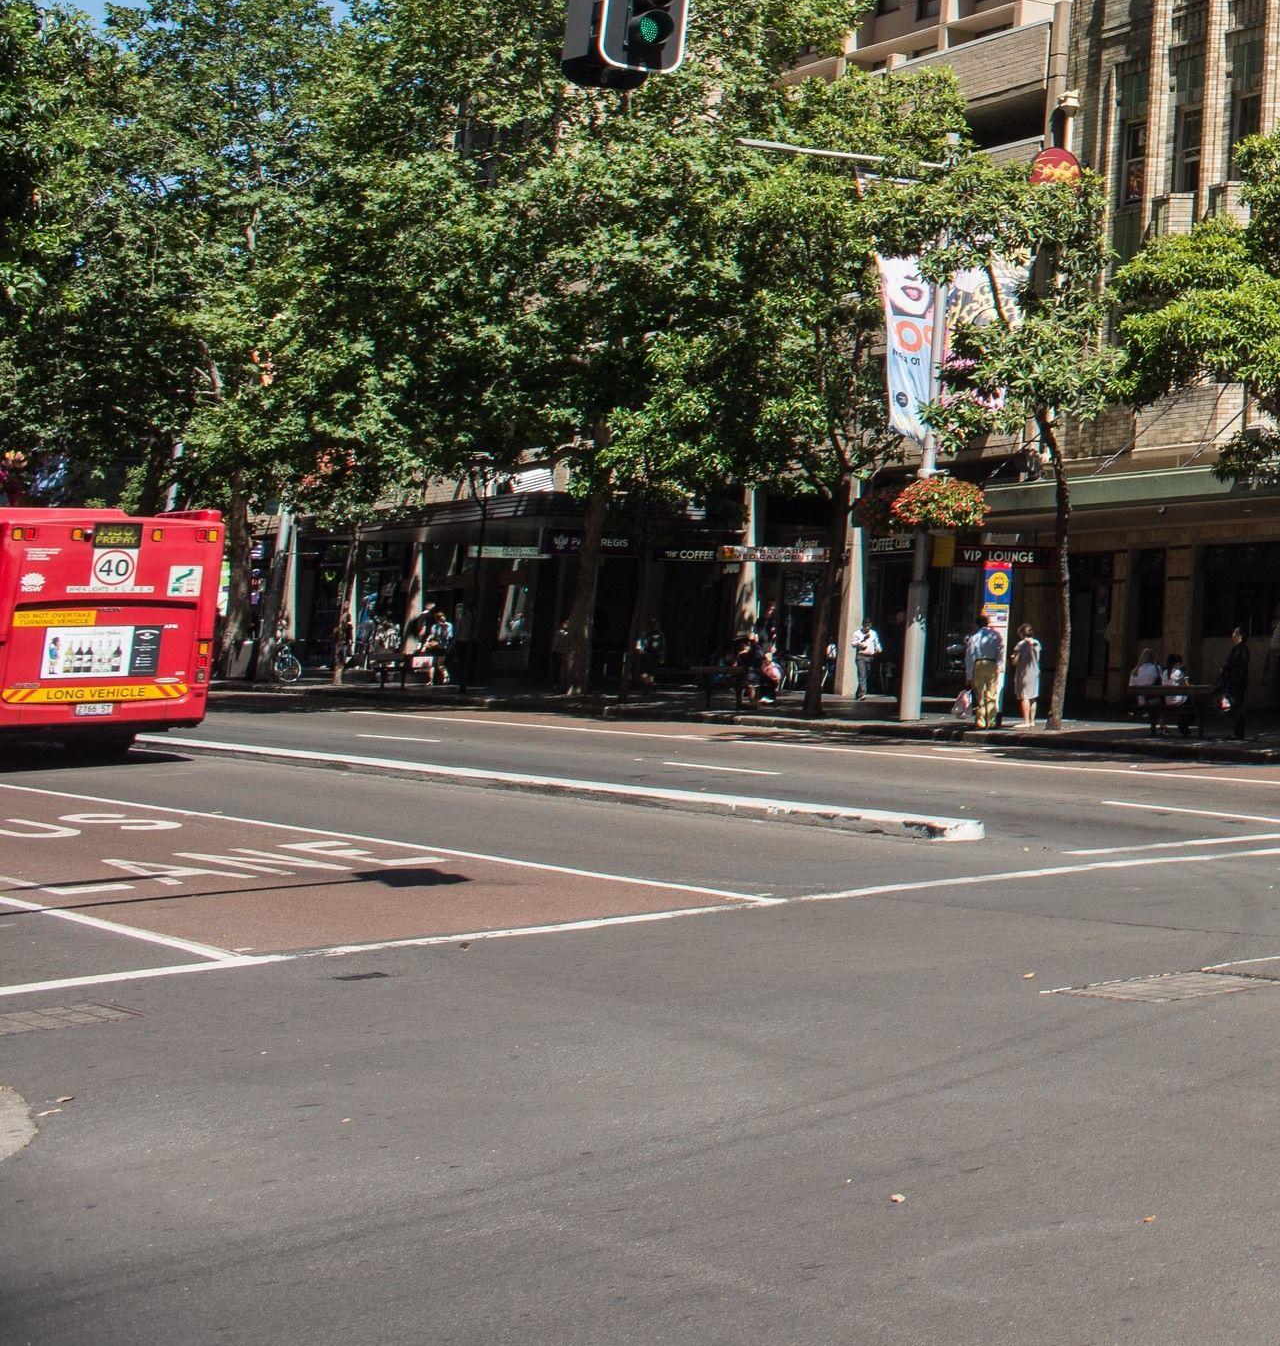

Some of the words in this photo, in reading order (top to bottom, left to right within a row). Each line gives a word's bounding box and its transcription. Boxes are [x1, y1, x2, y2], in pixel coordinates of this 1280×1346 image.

[95, 536, 138, 544] PREPAY
[601, 538, 629, 548] REGIS
[680, 550, 715, 560] COFFEE
[964, 549, 982, 562] VIP
[988, 551, 1035, 564] LOUNGE
[98, 558, 130, 577] 40
[20, 585, 42, 593] NSW
[46, 689, 85, 700] LONG
[88, 687, 145, 698] VEHICLE
[39, 840, 452, 895] LANE
